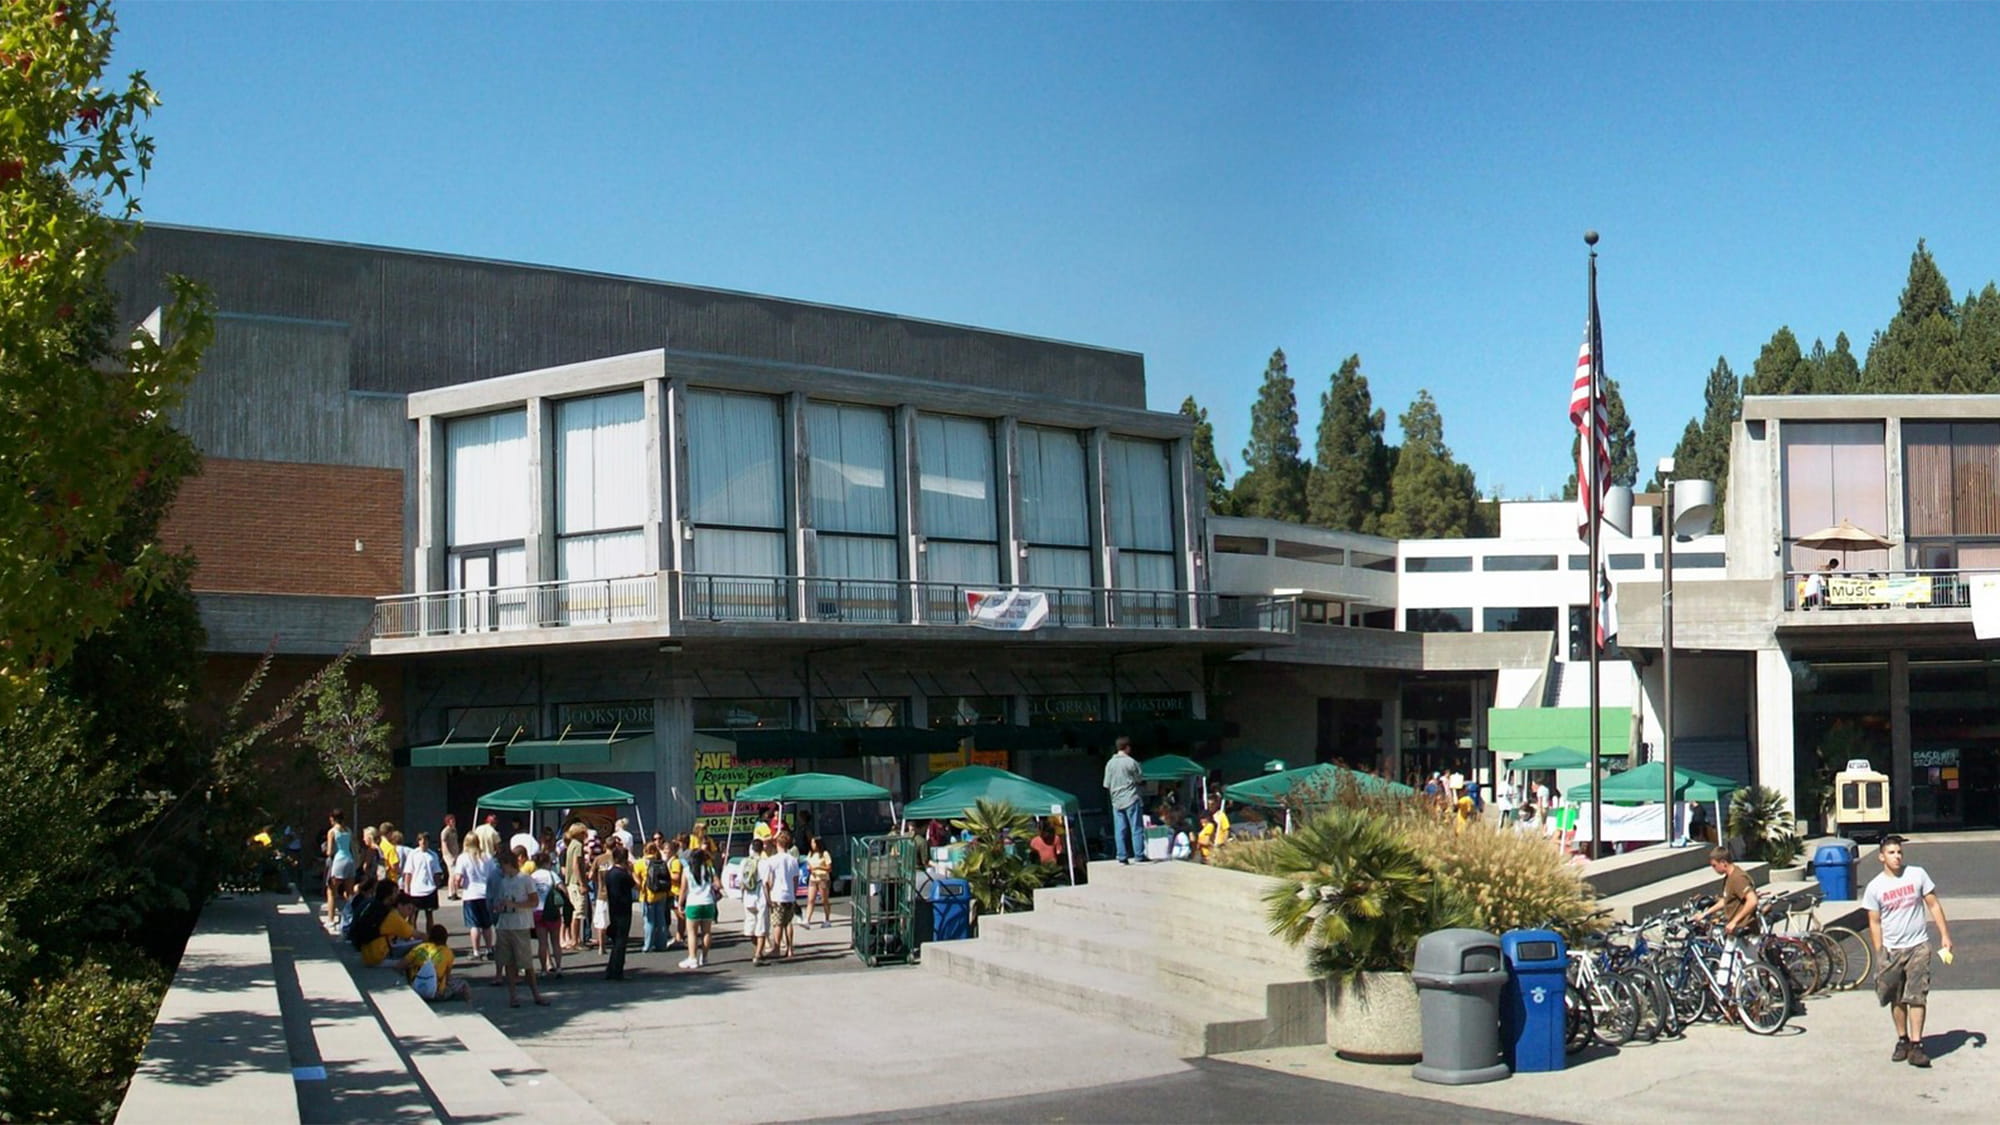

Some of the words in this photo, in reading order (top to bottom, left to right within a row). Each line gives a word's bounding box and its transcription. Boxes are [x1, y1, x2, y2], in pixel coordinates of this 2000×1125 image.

[1832, 586, 1876, 598] MUSIC
[1121, 697, 1184, 712] OOKSTORE
[1882, 884, 1915, 901] ARVIN
